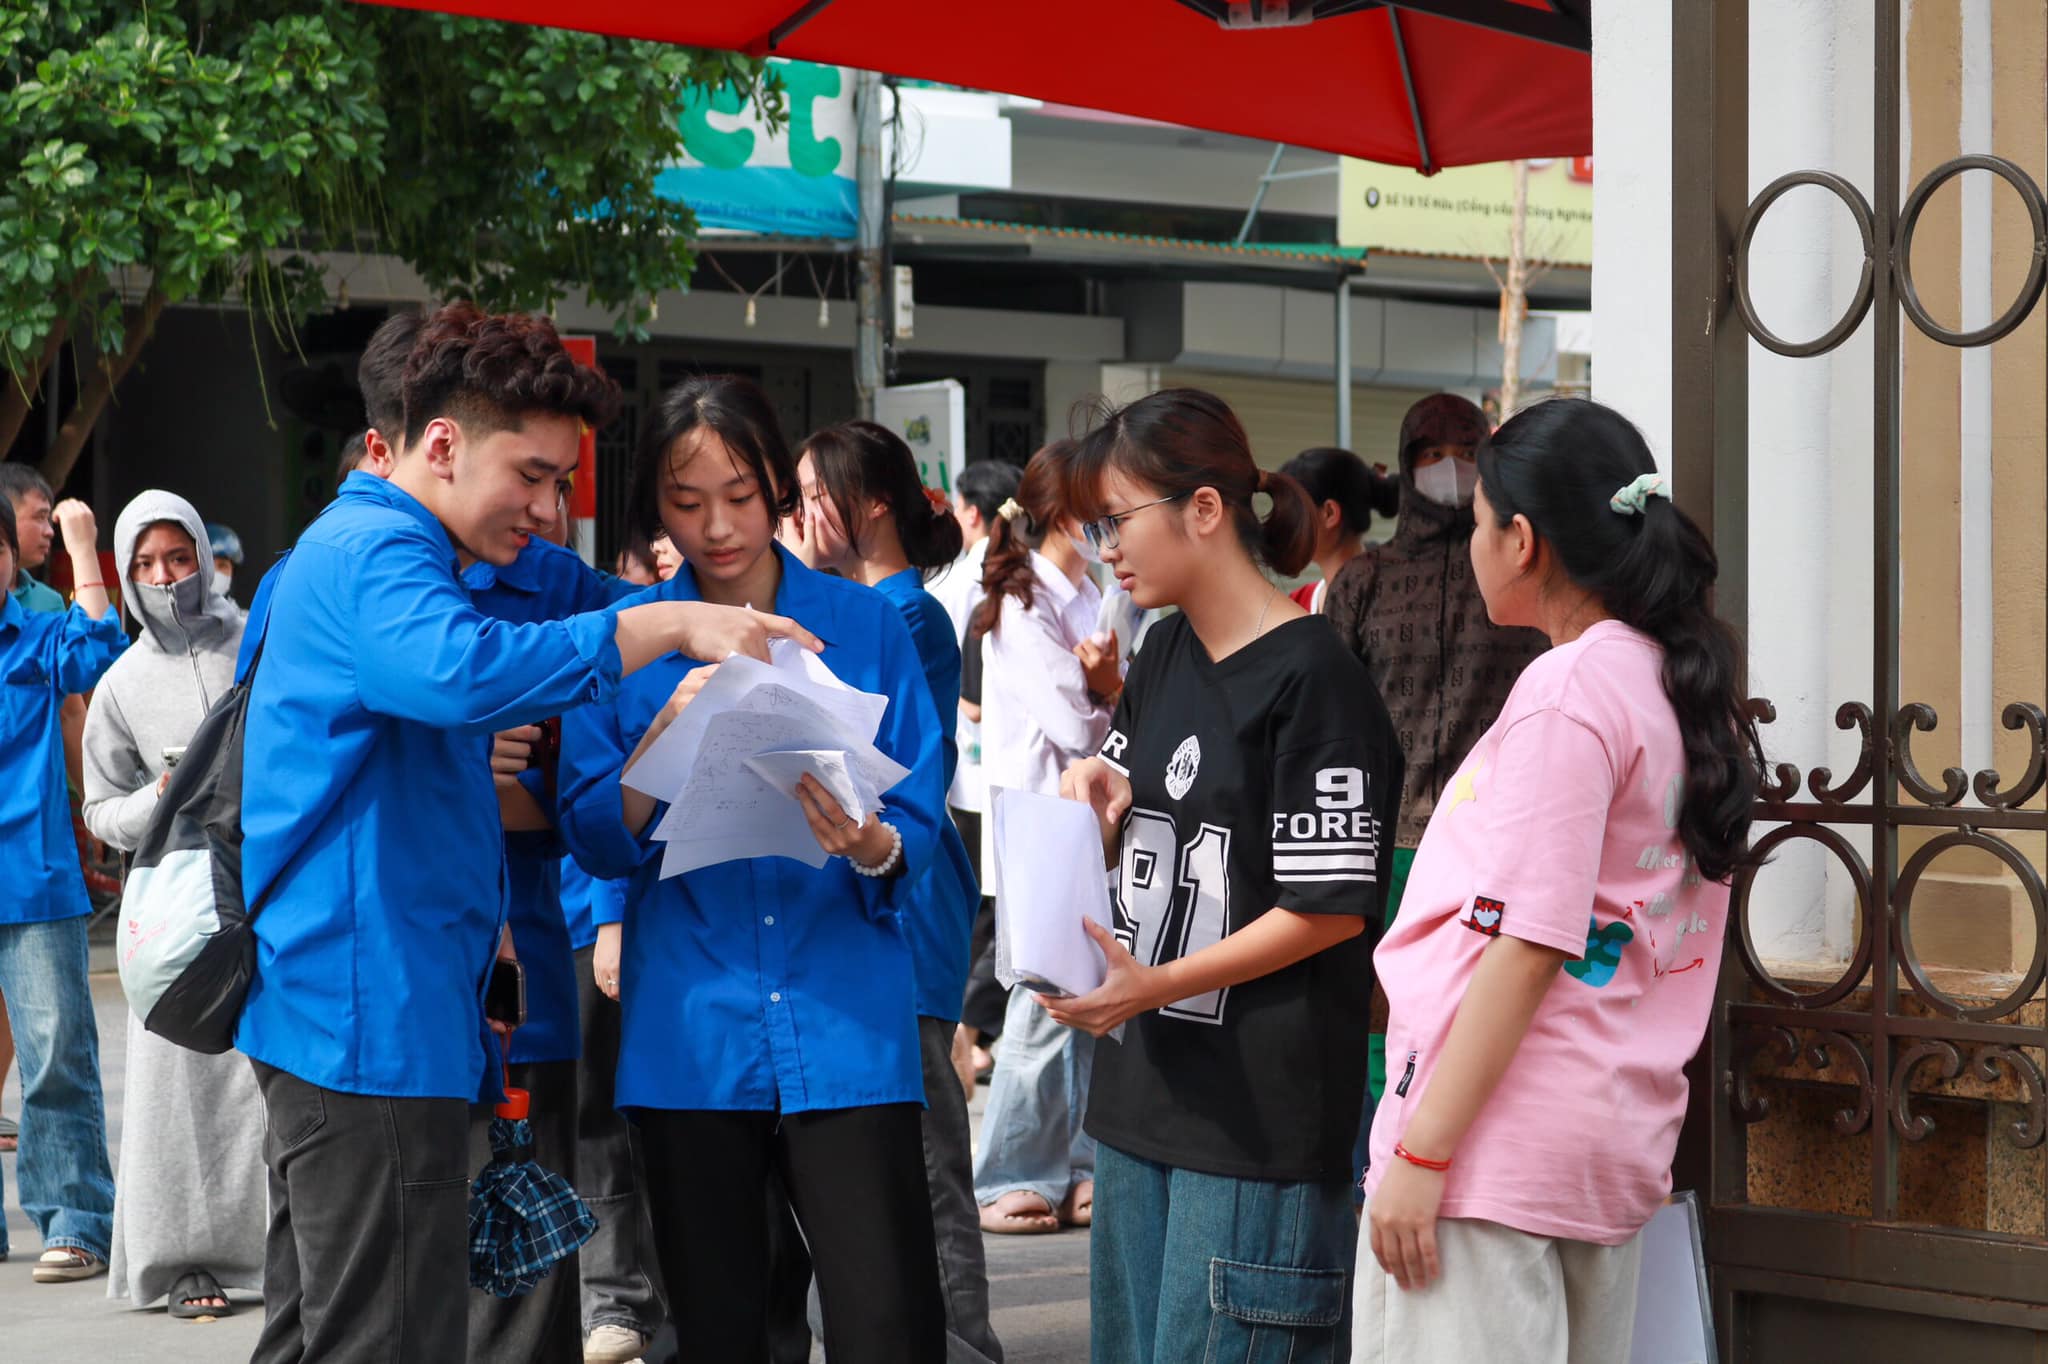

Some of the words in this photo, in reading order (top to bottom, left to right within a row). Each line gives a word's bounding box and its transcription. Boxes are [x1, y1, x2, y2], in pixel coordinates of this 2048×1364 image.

[1101, 729, 1128, 760] R
[1315, 767, 1370, 809] 9
[1114, 807, 1231, 1025] 91
